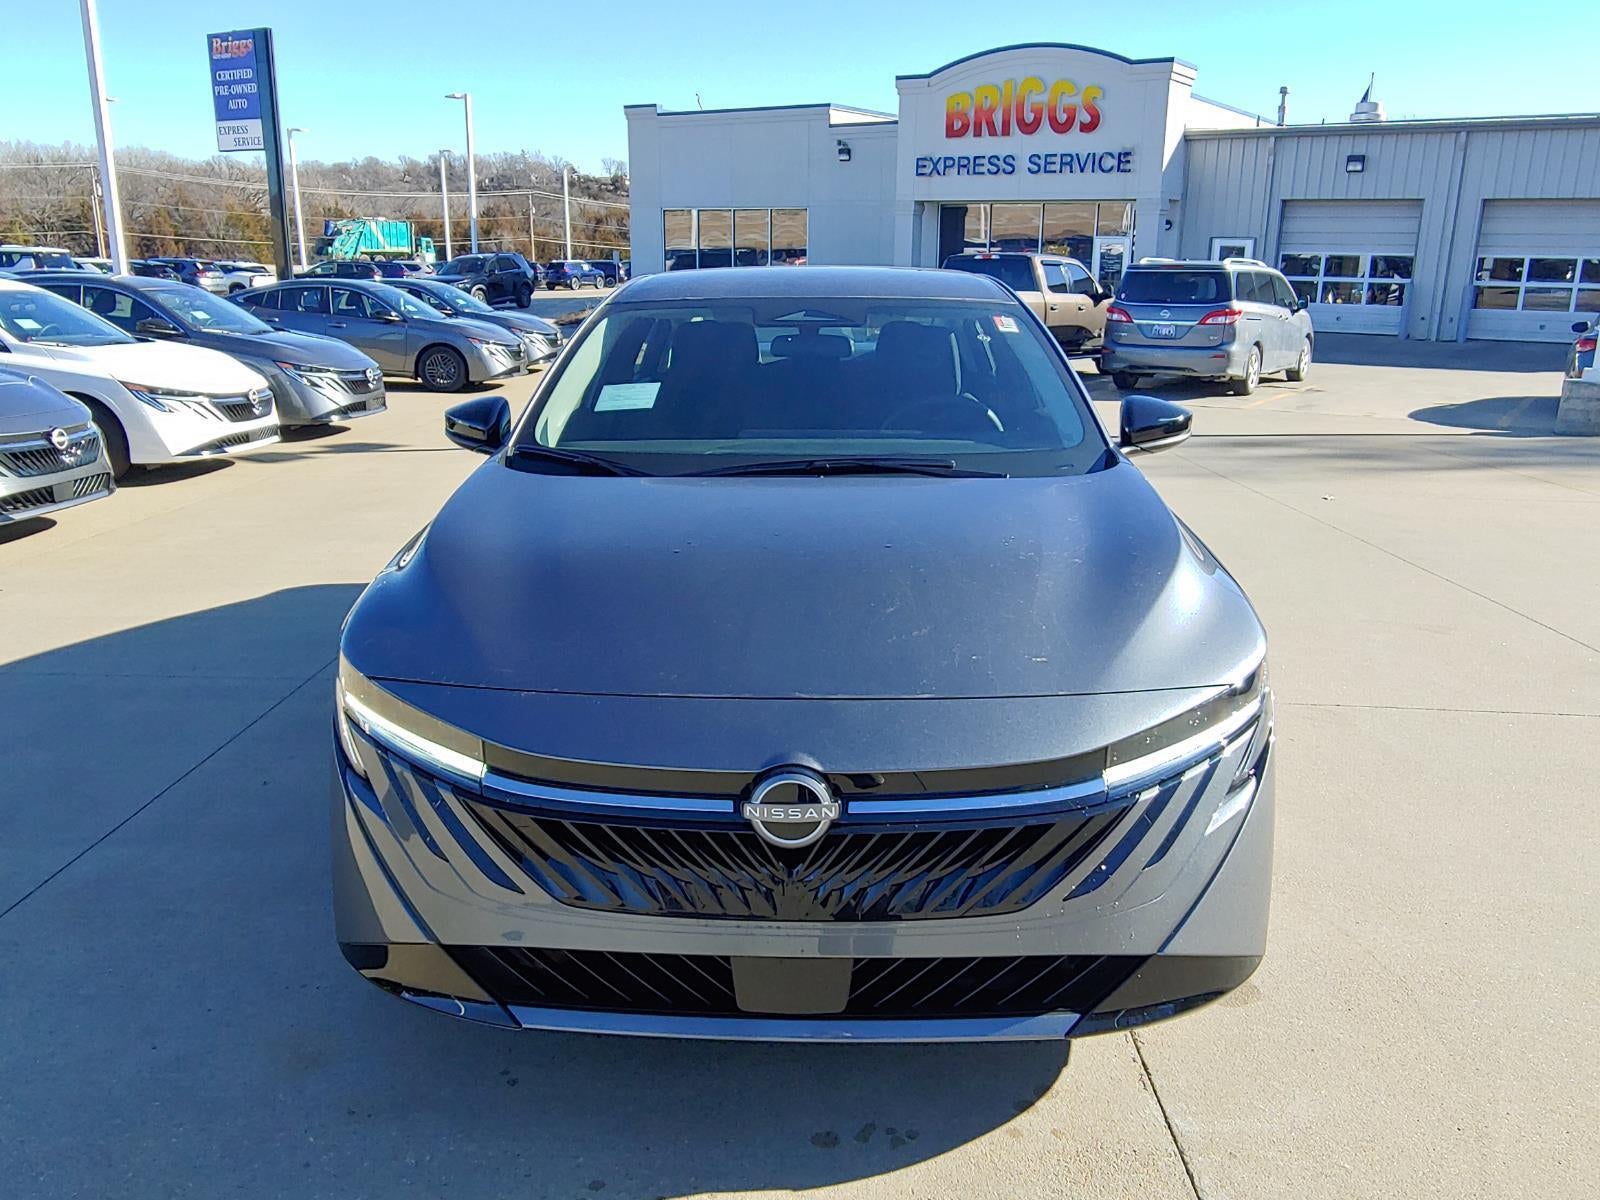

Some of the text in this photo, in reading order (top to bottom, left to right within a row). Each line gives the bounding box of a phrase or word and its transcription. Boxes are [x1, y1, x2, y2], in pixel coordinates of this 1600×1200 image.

[212, 36, 253, 58] Briggs
[216, 68, 253, 81] CERTIFIED
[214, 83, 257, 96] PRE-OWNED
[228, 98, 248, 110] AUTO
[945, 75, 1103, 139] BRIGGS
[218, 125, 249, 136] EXPRESS
[233, 136, 262, 147] SERVICE
[915, 151, 1132, 177] EXPRESS SERVICE
[746, 806, 836, 819] NISSAN
